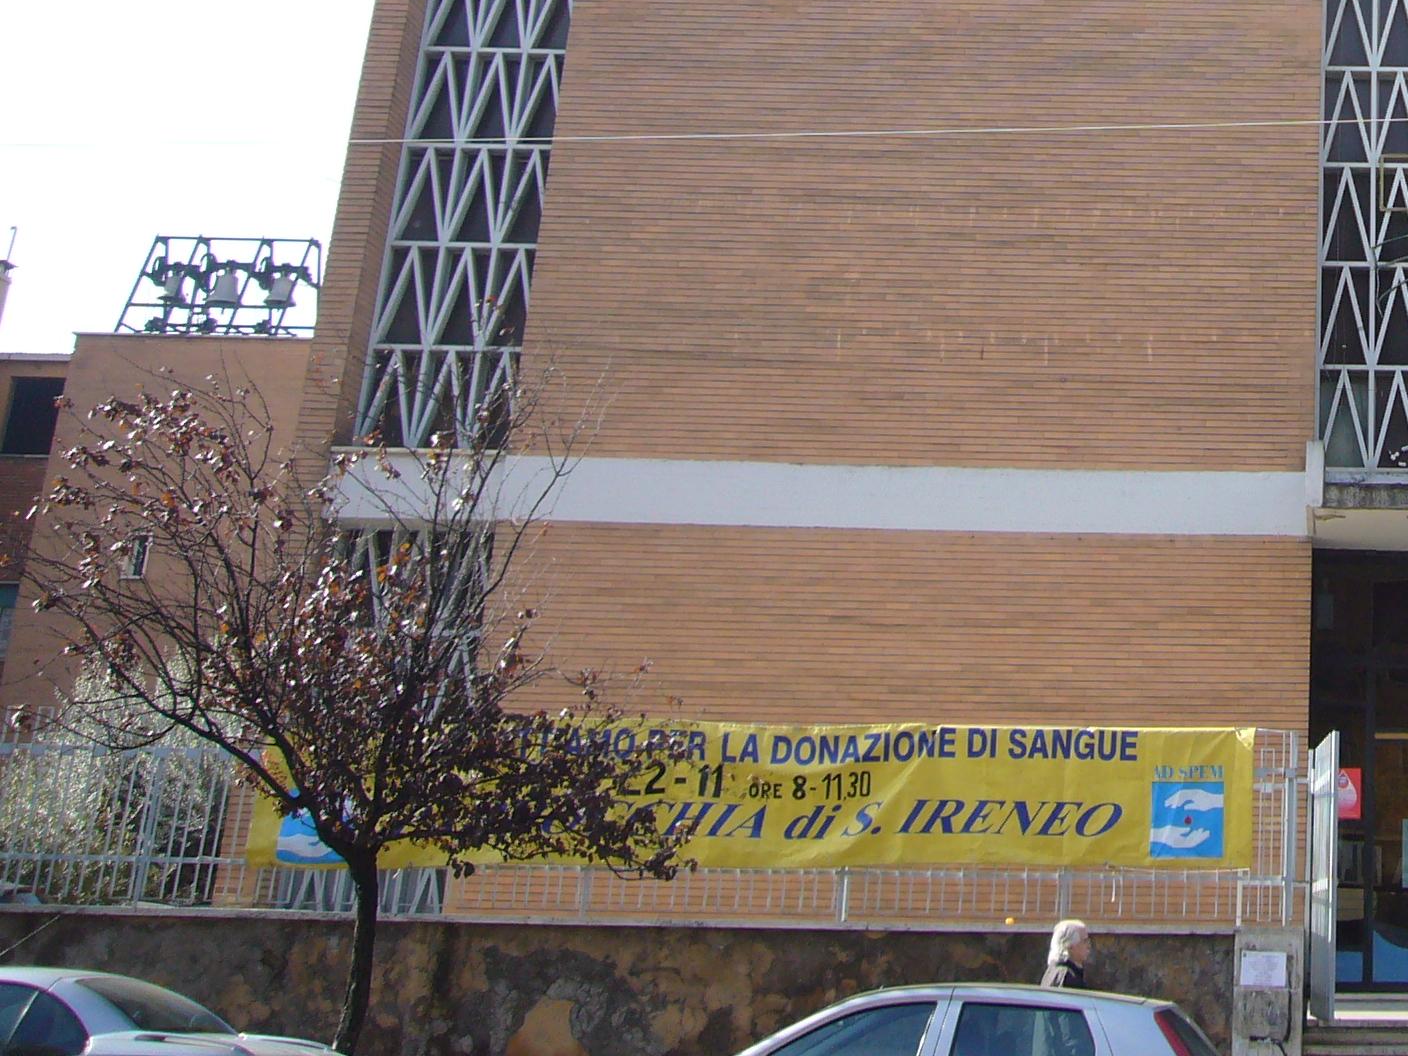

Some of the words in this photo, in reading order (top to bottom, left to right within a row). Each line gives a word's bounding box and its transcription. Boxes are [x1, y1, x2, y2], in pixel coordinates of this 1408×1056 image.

[648, 728, 706, 761] PER
[721, 731, 760, 764] LA
[770, 727, 956, 766] DONAZIONE
[967, 727, 997, 758] DI
[1008, 729, 1139, 762] SANGUE
[1153, 765, 1173, 779] AD
[1179, 765, 1223, 779] SPEM
[748, 782, 782, 800] ORE
[783, 804, 842, 840] di
[840, 800, 882, 837] S.
[894, 799, 1123, 838] IRENEO
